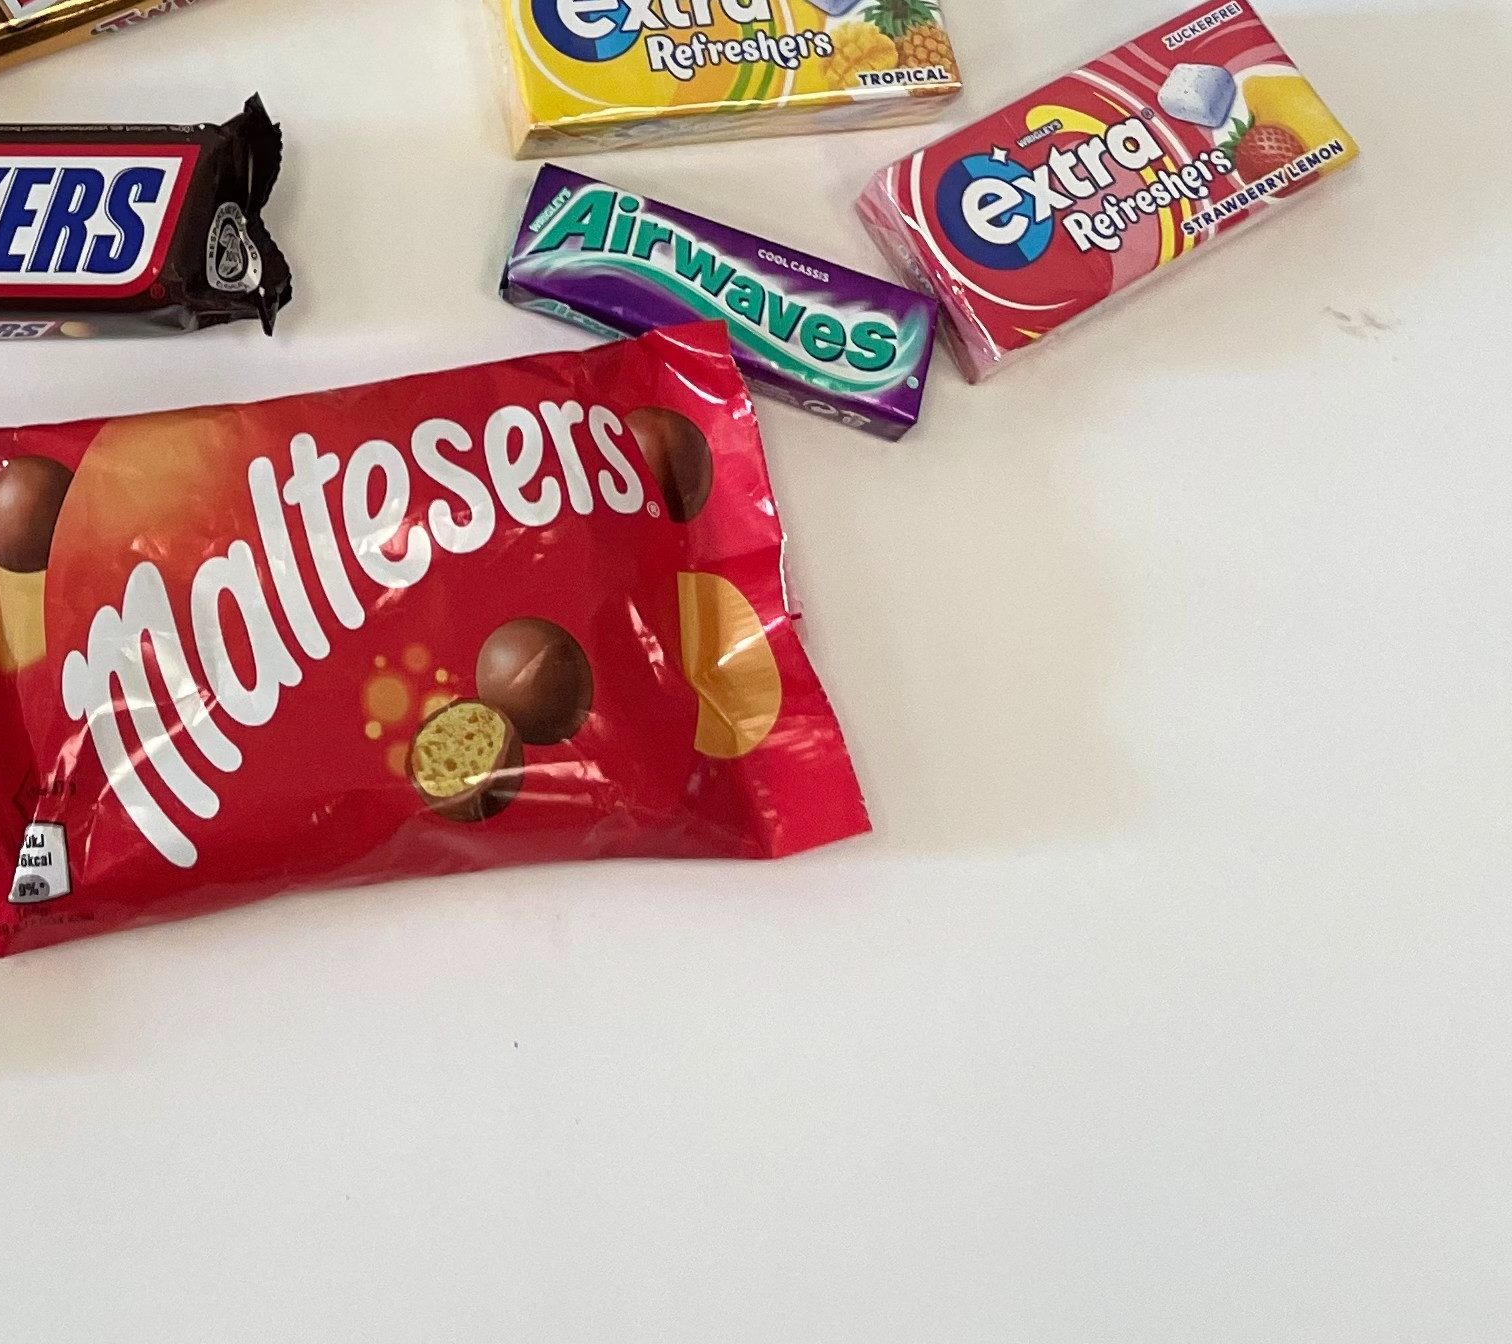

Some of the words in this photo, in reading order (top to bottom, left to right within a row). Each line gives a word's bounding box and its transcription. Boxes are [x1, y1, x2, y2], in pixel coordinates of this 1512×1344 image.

[646, 30, 834, 80] Refreshers
[1163, 2, 1241, 49] ZUCKERFREI
[859, 67, 948, 85] TROPICAL
[961, 115, 1163, 245] extra
[1063, 148, 1233, 253] Refreshers
[1182, 171, 1286, 235] STRAWBERRY
[1287, 140, 1344, 180] LEMON
[529, 190, 898, 371] Airwaves
[757, 248, 788, 268] COOL
[789, 260, 830, 282] CASSIS
[62, 398, 645, 870] Maltesers
